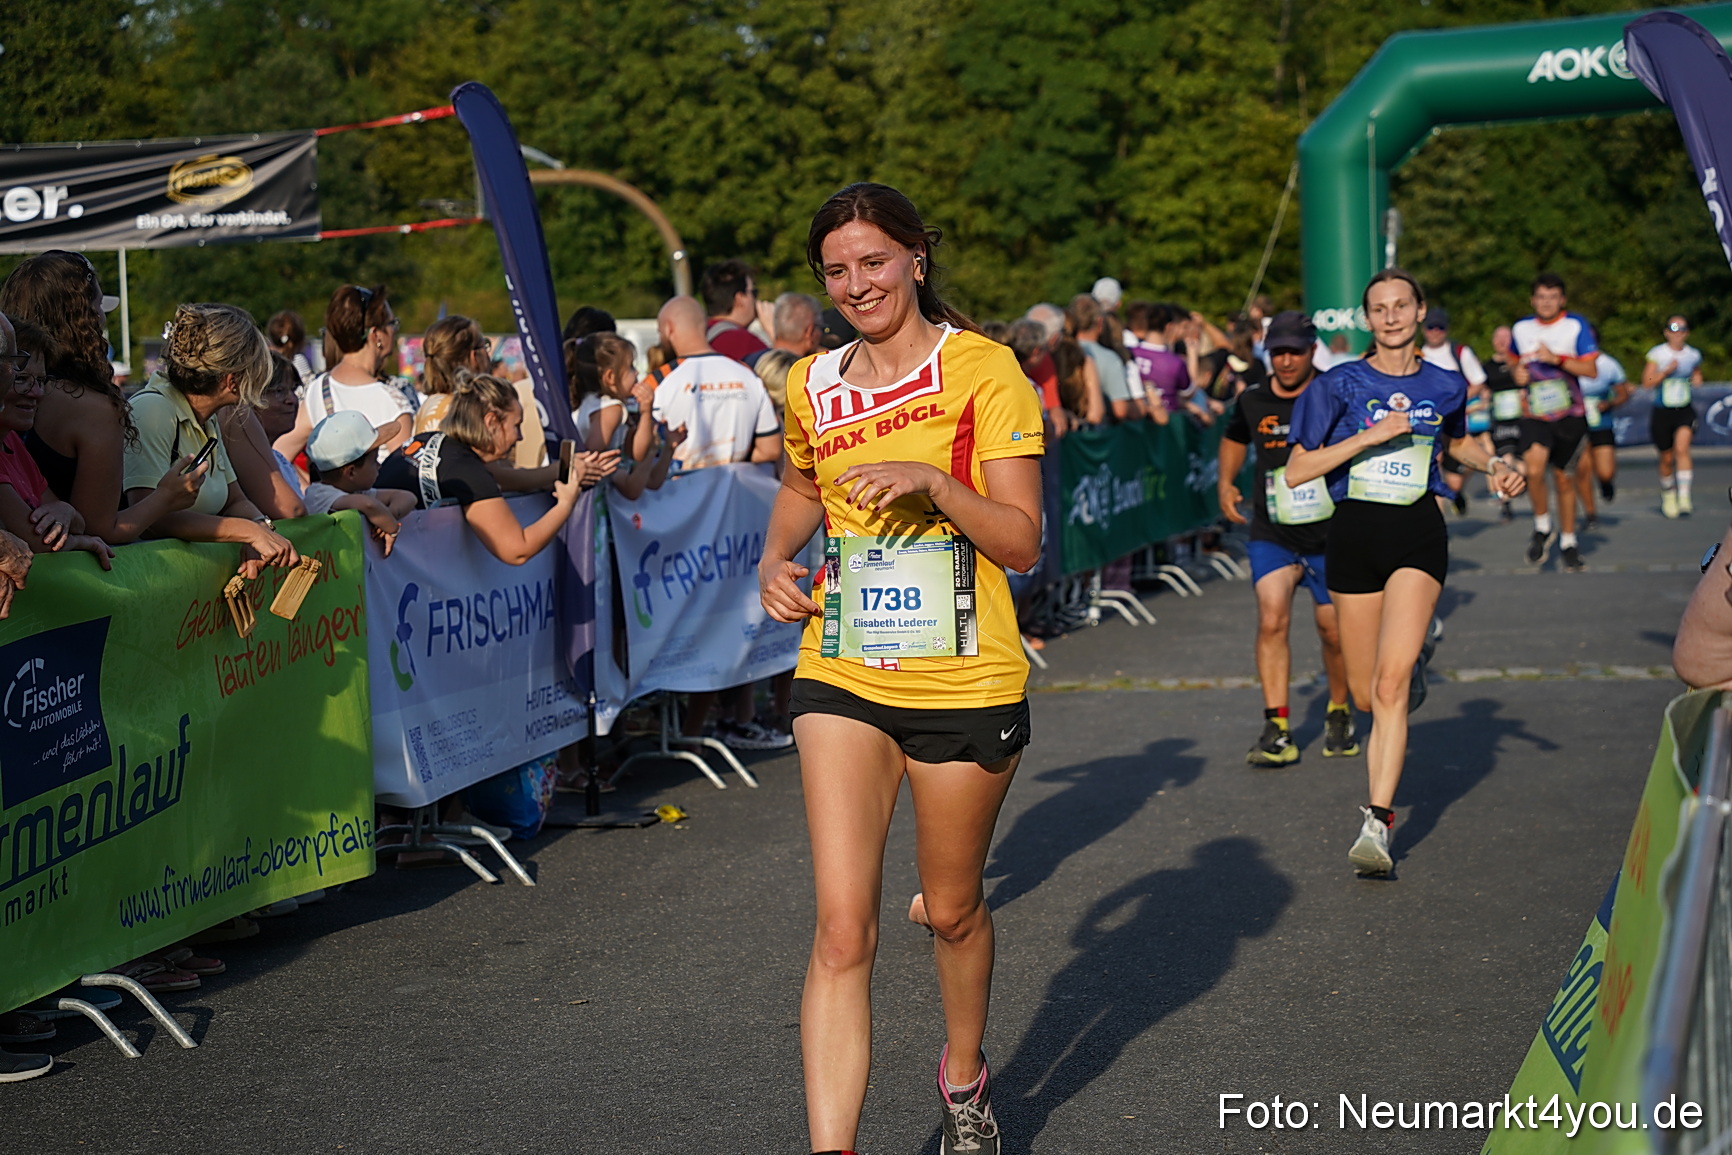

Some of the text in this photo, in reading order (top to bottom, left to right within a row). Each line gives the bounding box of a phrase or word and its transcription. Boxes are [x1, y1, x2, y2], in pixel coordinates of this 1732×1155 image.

[1527, 45, 1608, 83] AOK
[136, 214, 159, 229] Ein
[190, 213, 215, 227] der
[1312, 308, 1355, 331] AOK
[816, 428, 867, 464] MAX
[876, 403, 946, 438] BÖGL
[956, 578, 961, 587] 20
[860, 587, 922, 611] 1738
[853, 618, 938, 628] Elisabeth Lederer
[960, 612, 968, 647] HILTL
[214, 584, 369, 698] laufen länger!
[22, 674, 85, 718] Fischer
[29, 700, 83, 732] AUTOMOBILE
